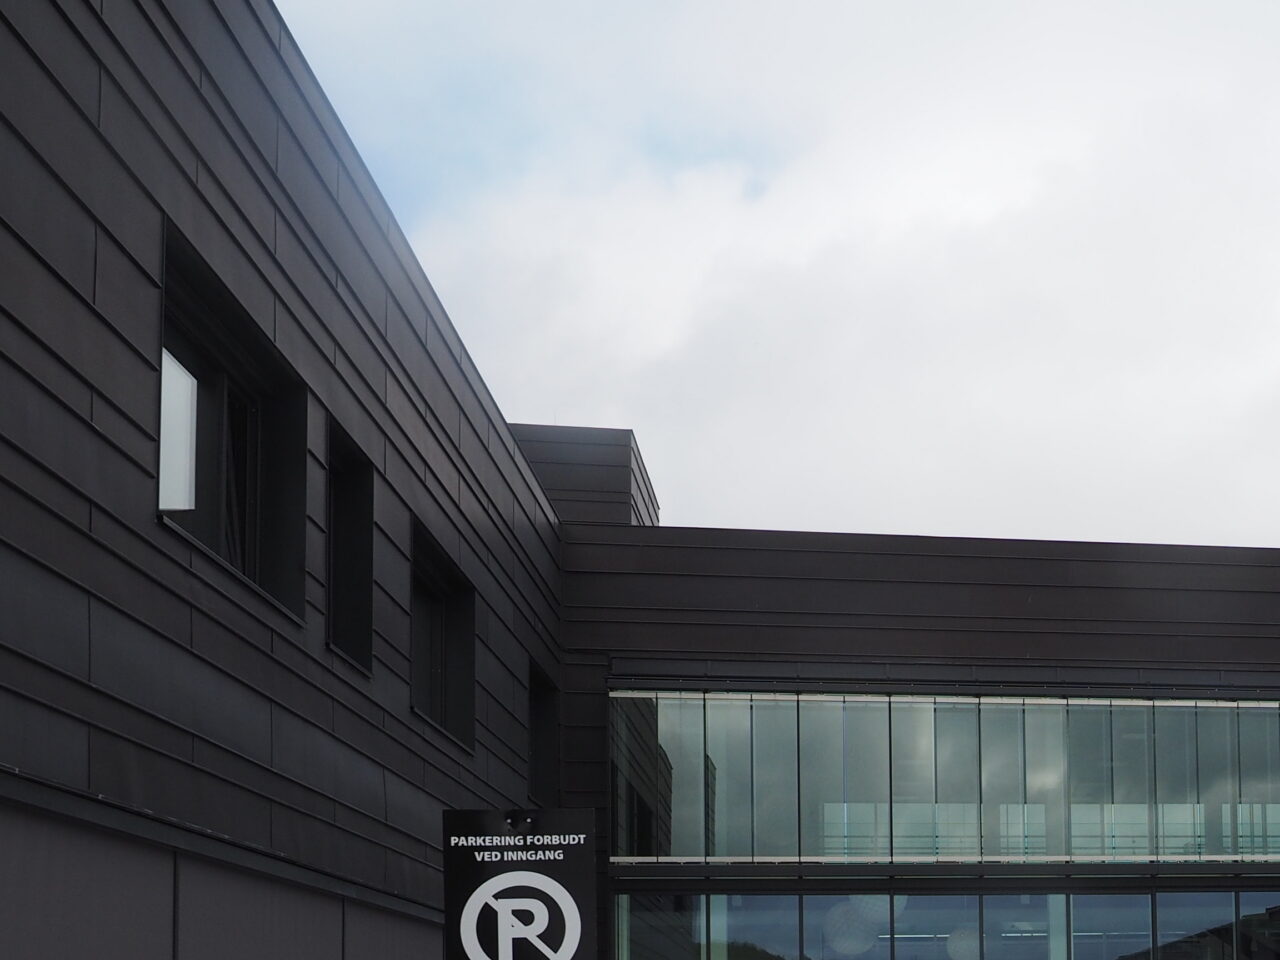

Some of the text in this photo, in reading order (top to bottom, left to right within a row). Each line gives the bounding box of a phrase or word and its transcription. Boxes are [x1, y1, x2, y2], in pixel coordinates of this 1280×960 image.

[450, 834, 587, 847] PARKERING FORBUDT
[474, 850, 564, 862] VED INNGANG
